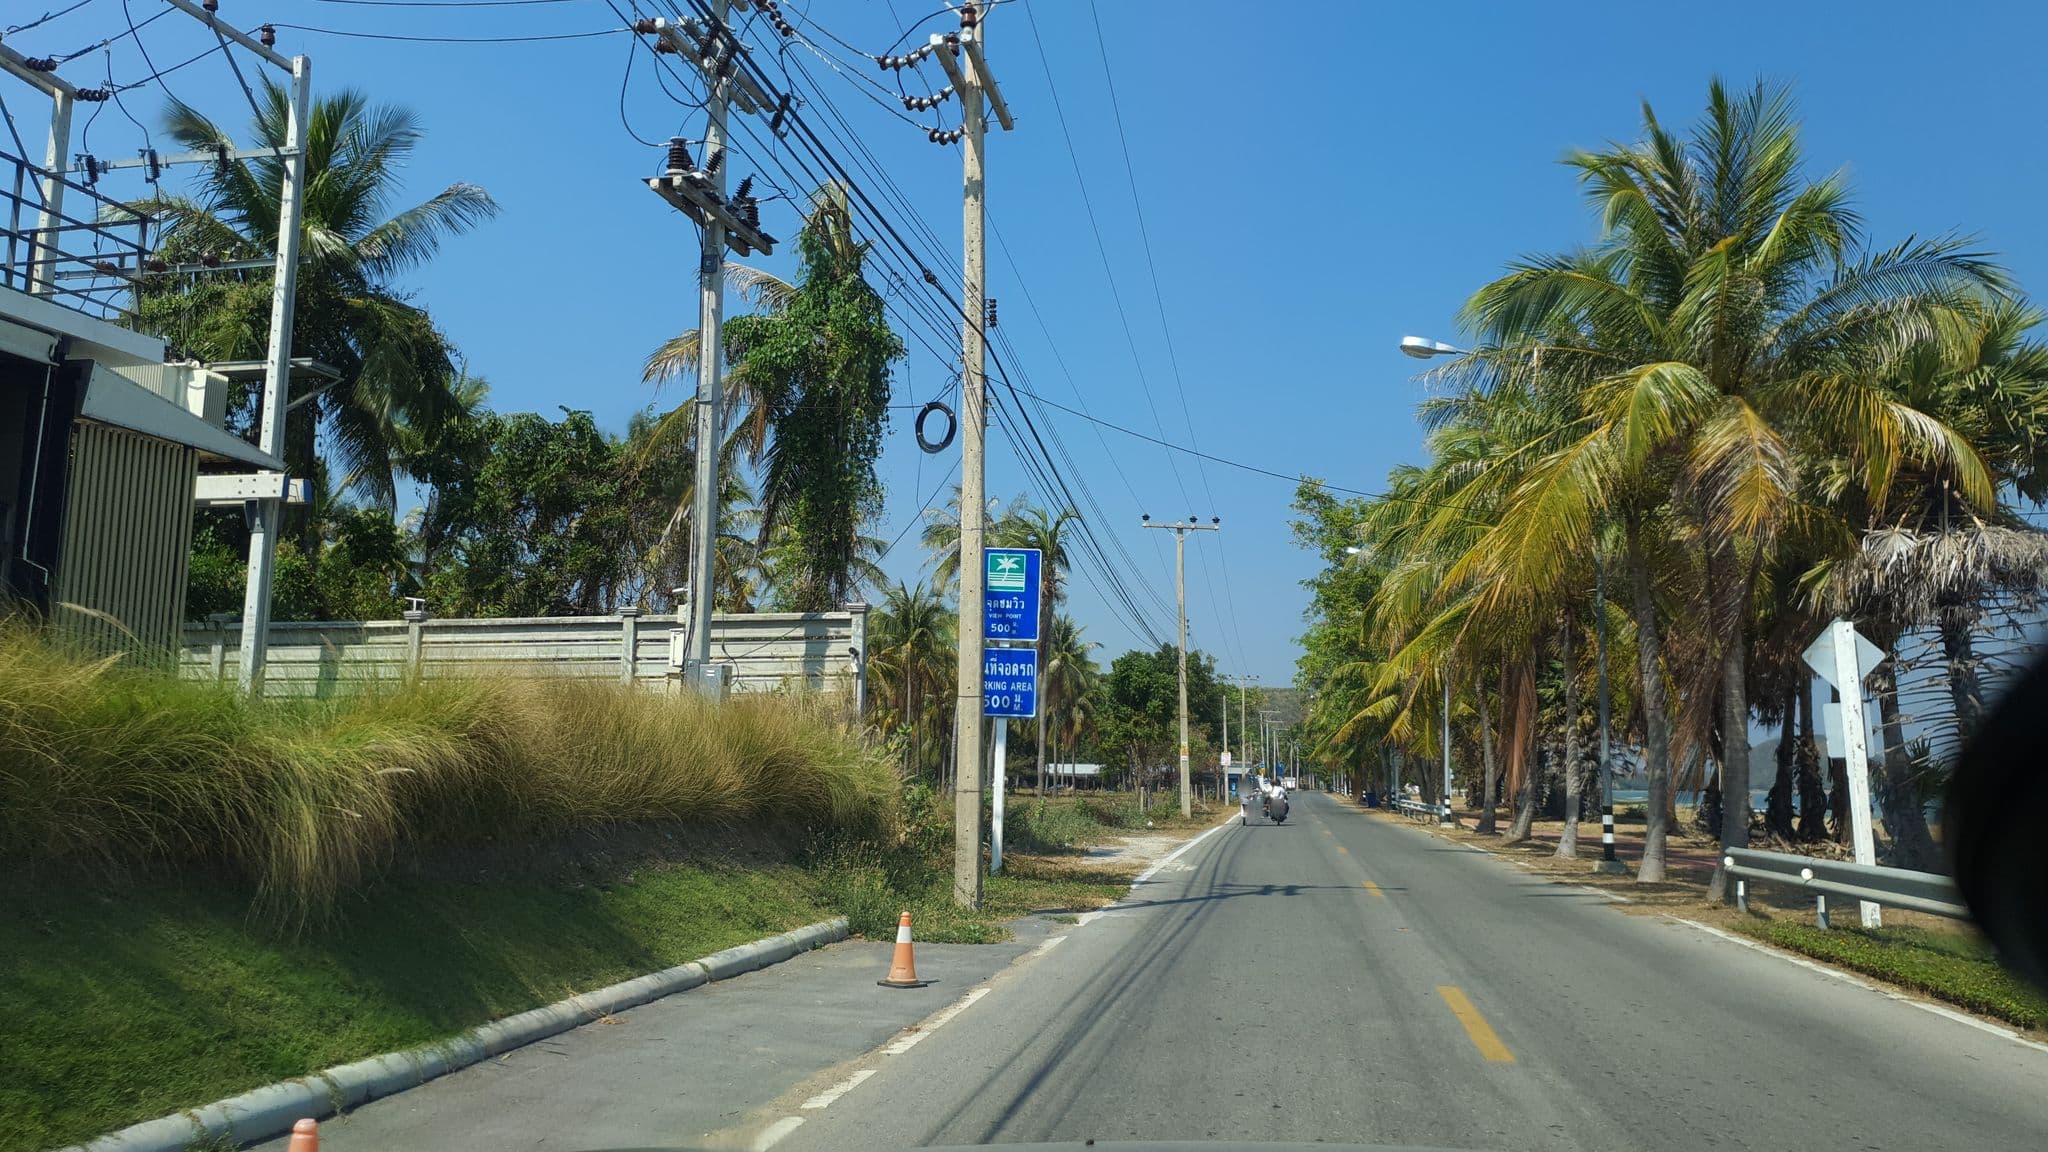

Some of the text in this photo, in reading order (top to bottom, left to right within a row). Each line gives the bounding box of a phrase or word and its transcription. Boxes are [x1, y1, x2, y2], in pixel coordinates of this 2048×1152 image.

[987, 596, 1025, 611] จุดชมวิว
[991, 623, 1010, 632] 500
[984, 681, 1033, 692] RKING AREA
[984, 694, 1010, 708] 500
